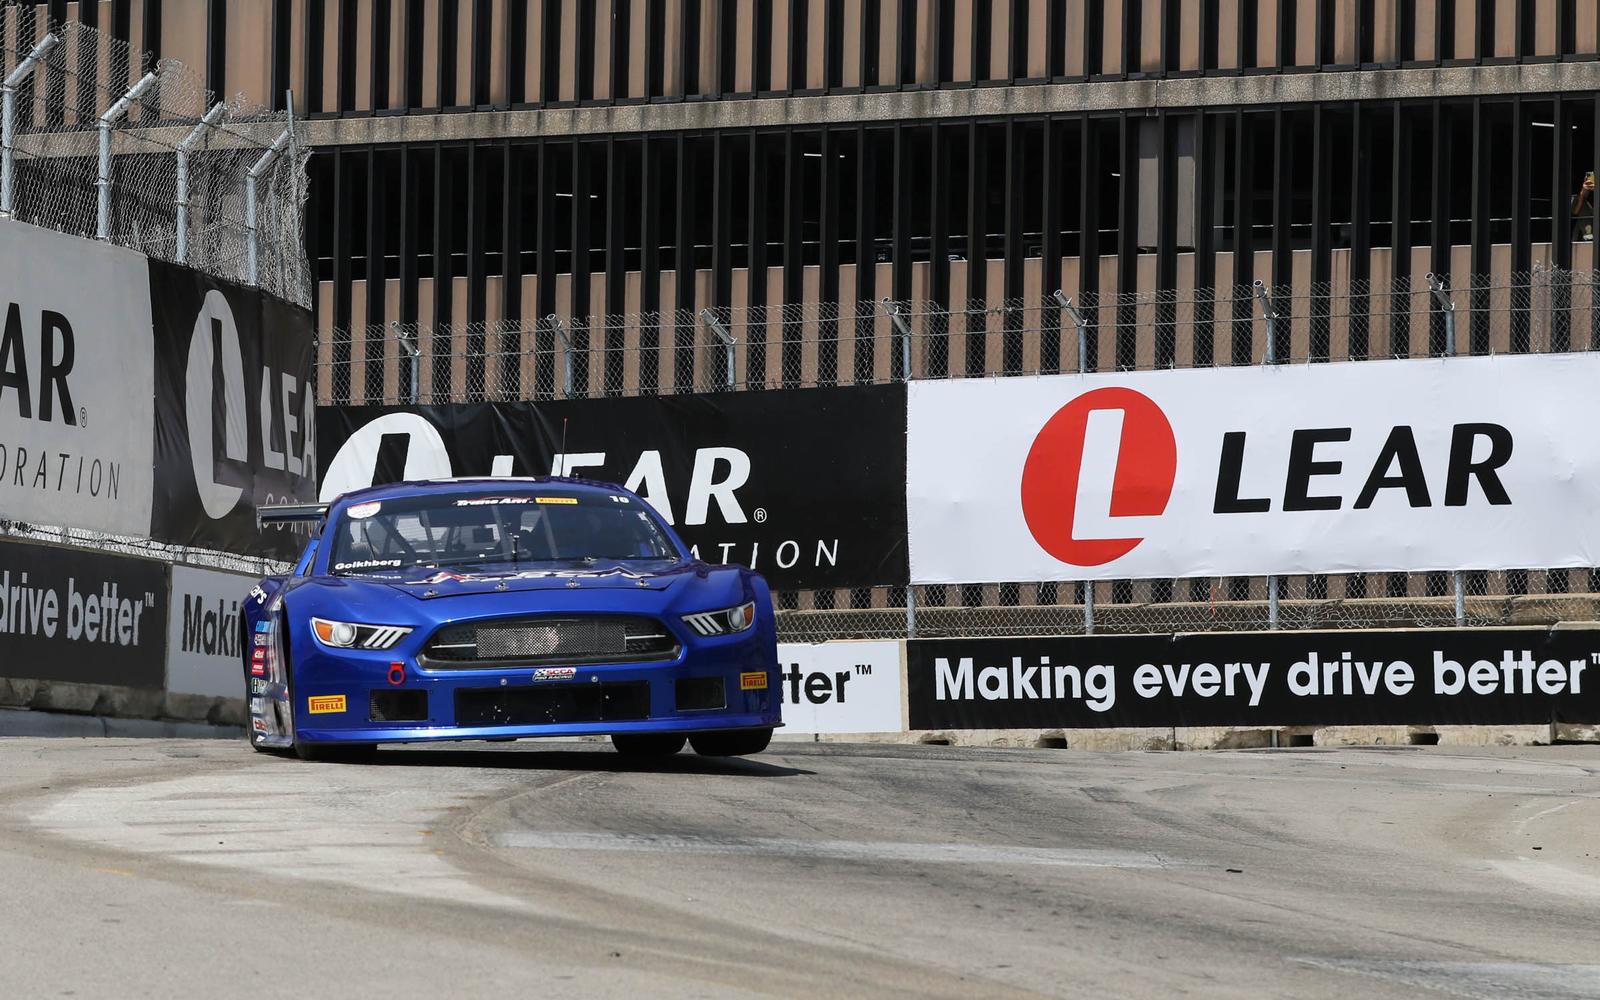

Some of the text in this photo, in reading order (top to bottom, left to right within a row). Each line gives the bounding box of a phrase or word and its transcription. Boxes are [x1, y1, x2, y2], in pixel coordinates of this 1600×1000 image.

[260, 366, 317, 485] LEA
[1212, 422, 1514, 514] LEAR
[0, 570, 59, 638] drive
[310, 697, 344, 711] PIRELLI
[545, 668, 574, 676] SCCA
[934, 655, 1116, 712] Making
[1132, 661, 1271, 707] every
[1286, 652, 1415, 696] drive
